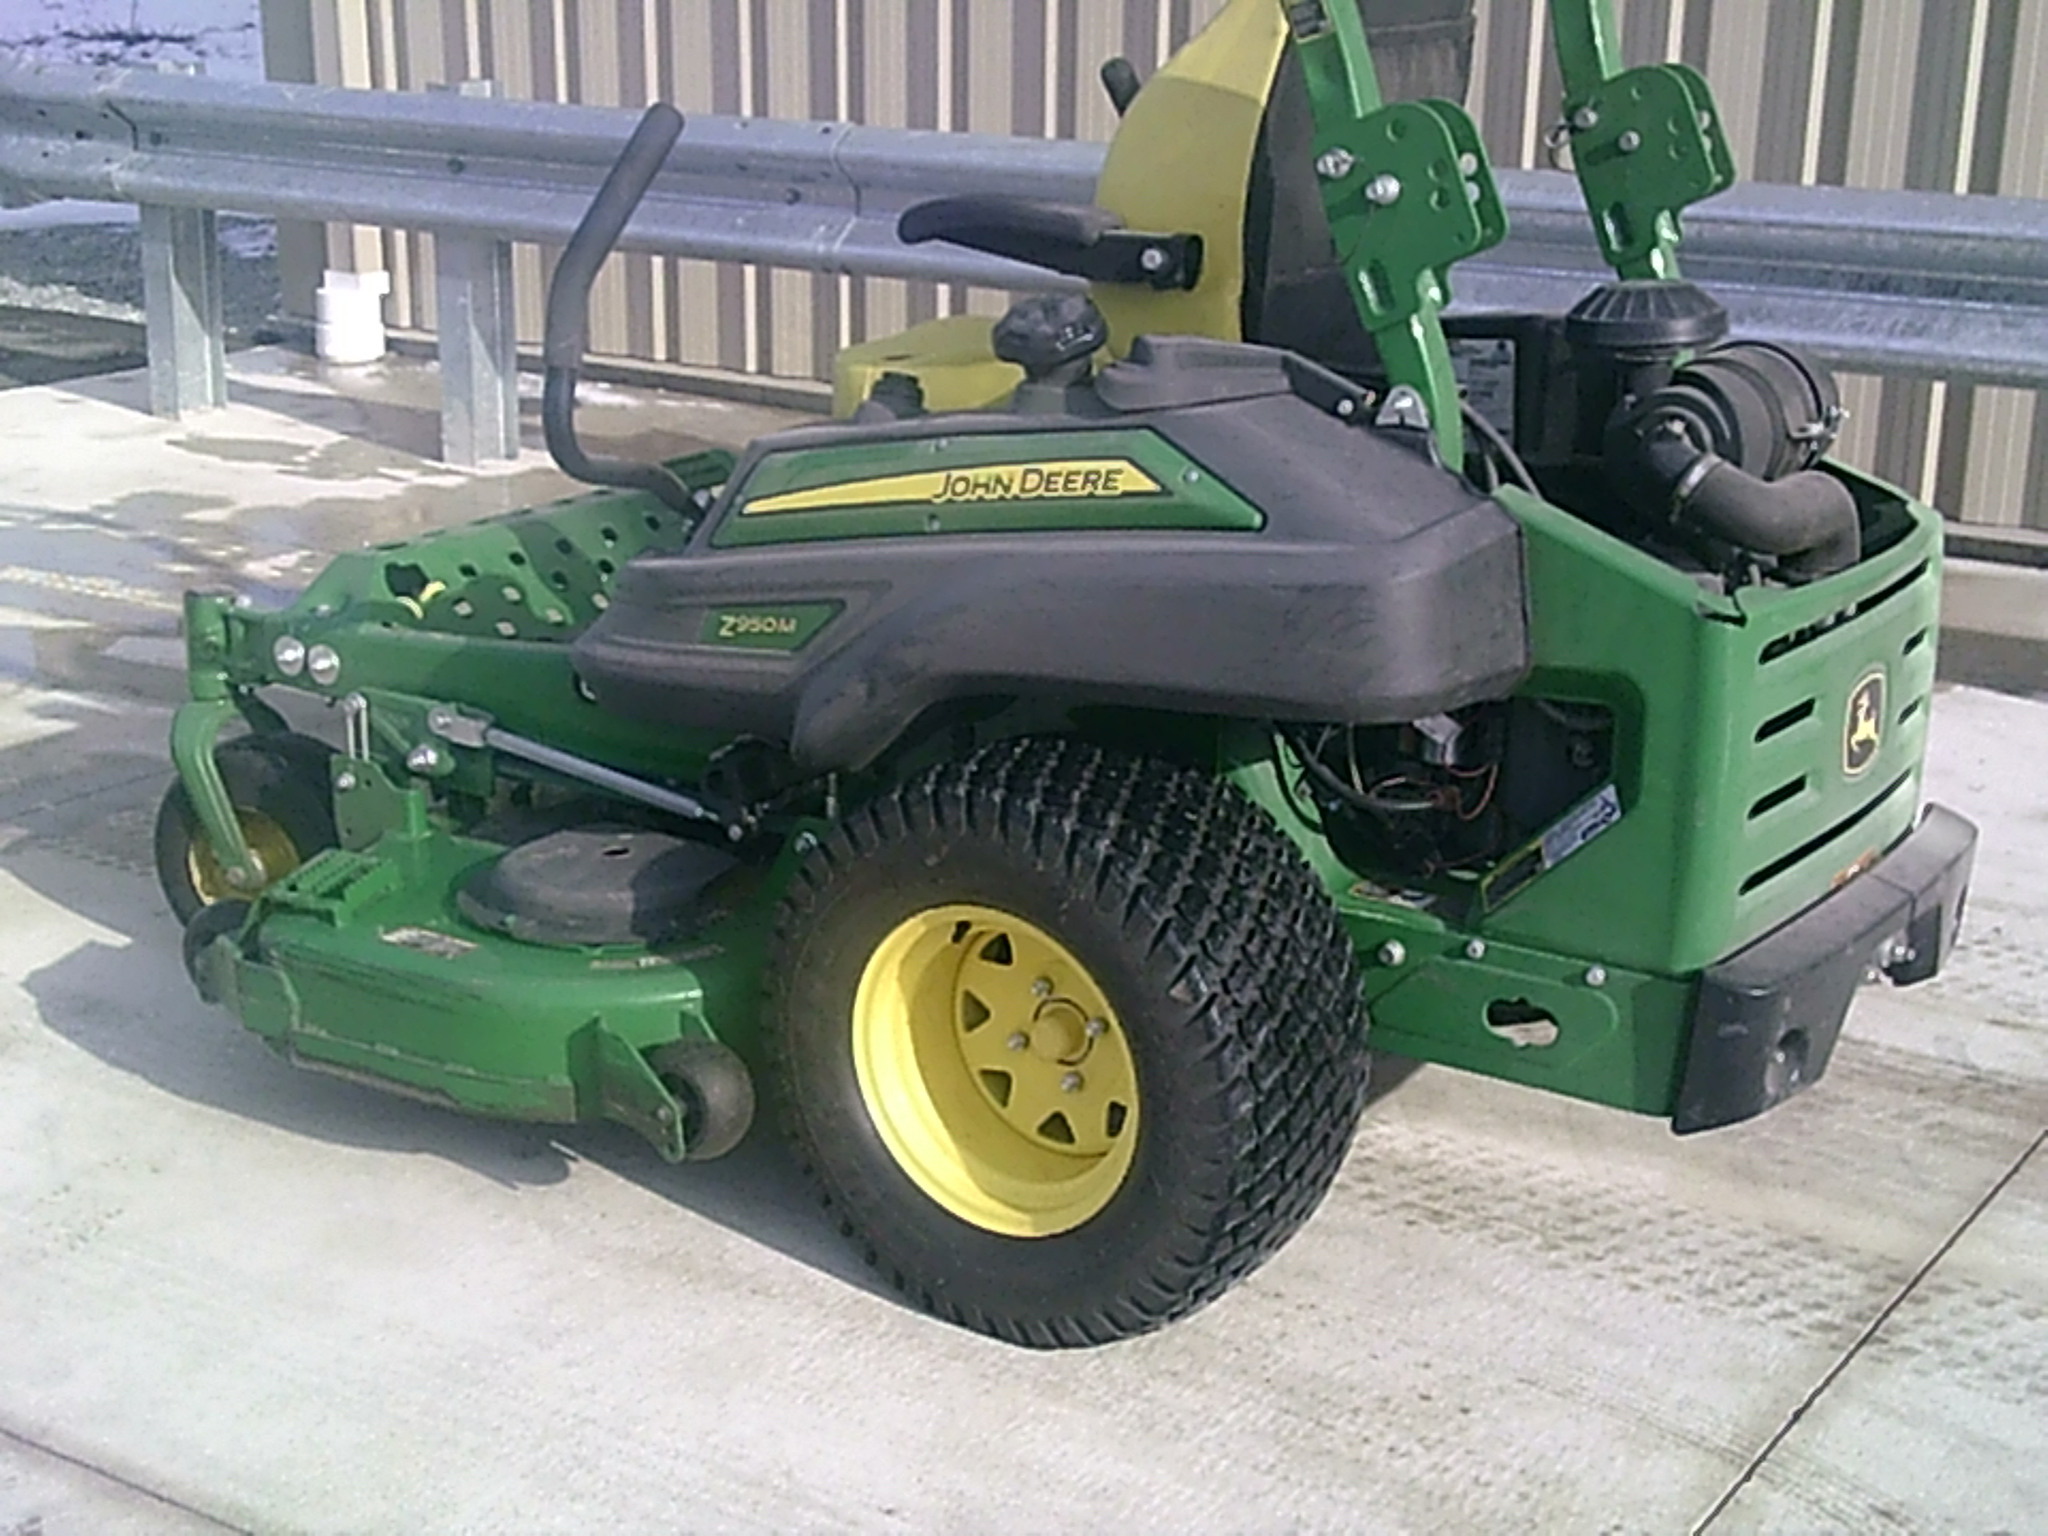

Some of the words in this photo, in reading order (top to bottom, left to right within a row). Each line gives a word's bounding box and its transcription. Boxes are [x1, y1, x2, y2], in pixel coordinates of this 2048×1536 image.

[933, 472, 1014, 499] JOHN
[1018, 467, 1125, 494] DEERE
[718, 615, 798, 637] Z950M
